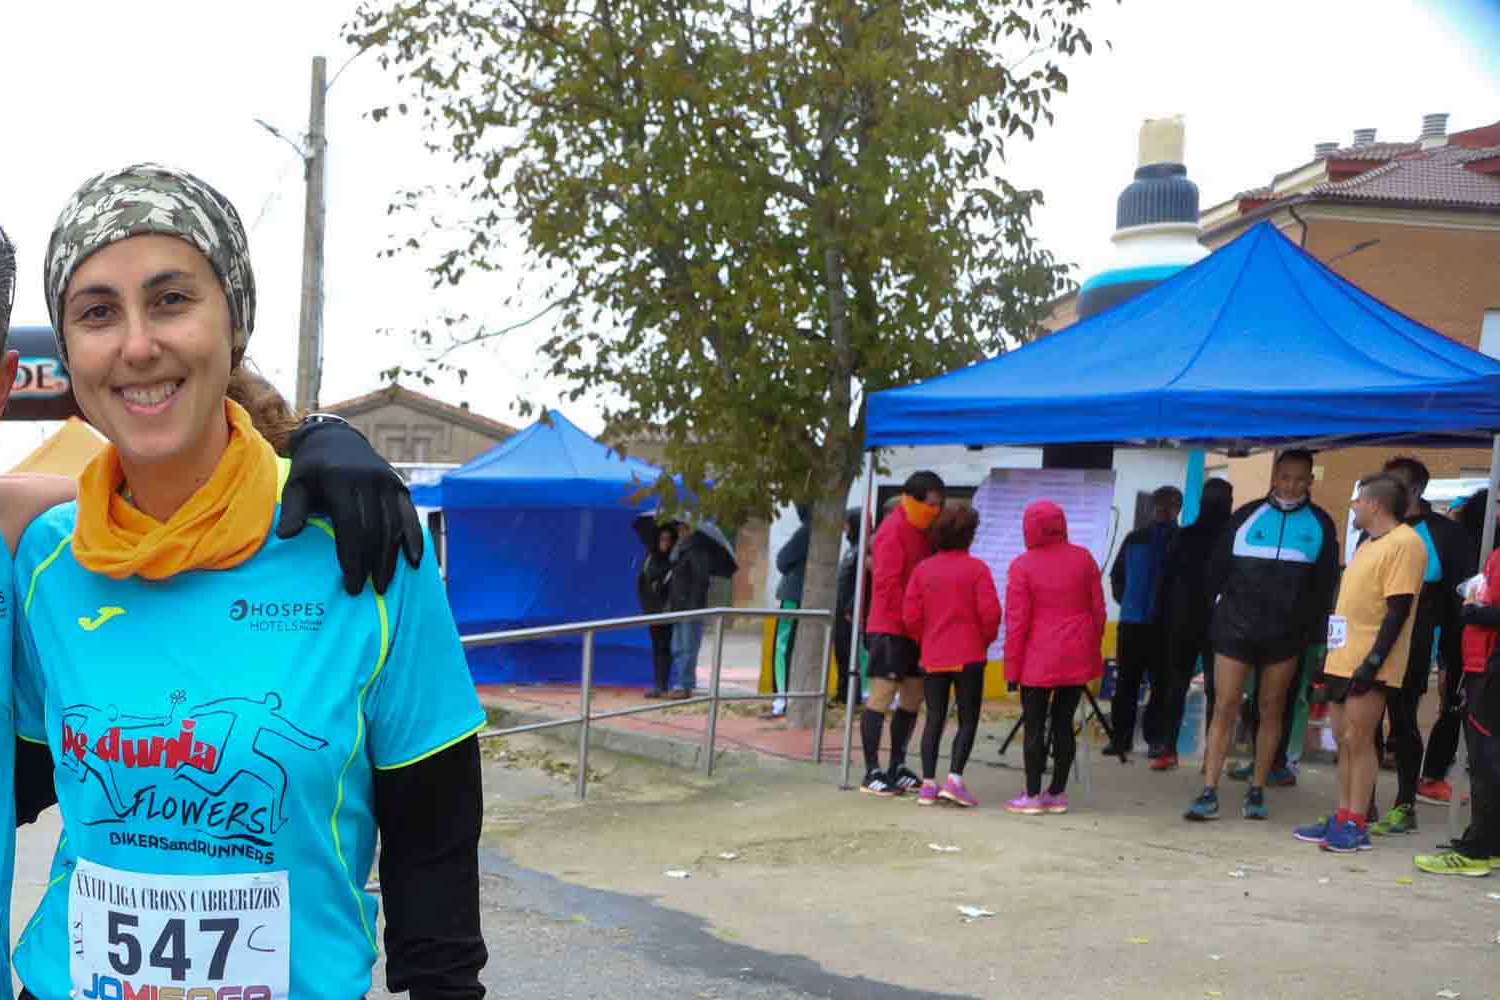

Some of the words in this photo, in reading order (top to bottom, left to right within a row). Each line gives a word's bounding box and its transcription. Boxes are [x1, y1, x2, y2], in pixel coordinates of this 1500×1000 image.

[251, 602, 325, 617] HOSPES
[131, 785, 268, 835] FLOWERS
[109, 832, 275, 865] BIKERSandRUNNERS
[108, 882, 137, 909] LIGA
[141, 888, 187, 912] CROSS
[190, 886, 280, 912] CABRERIZOS
[108, 911, 239, 981] 547
